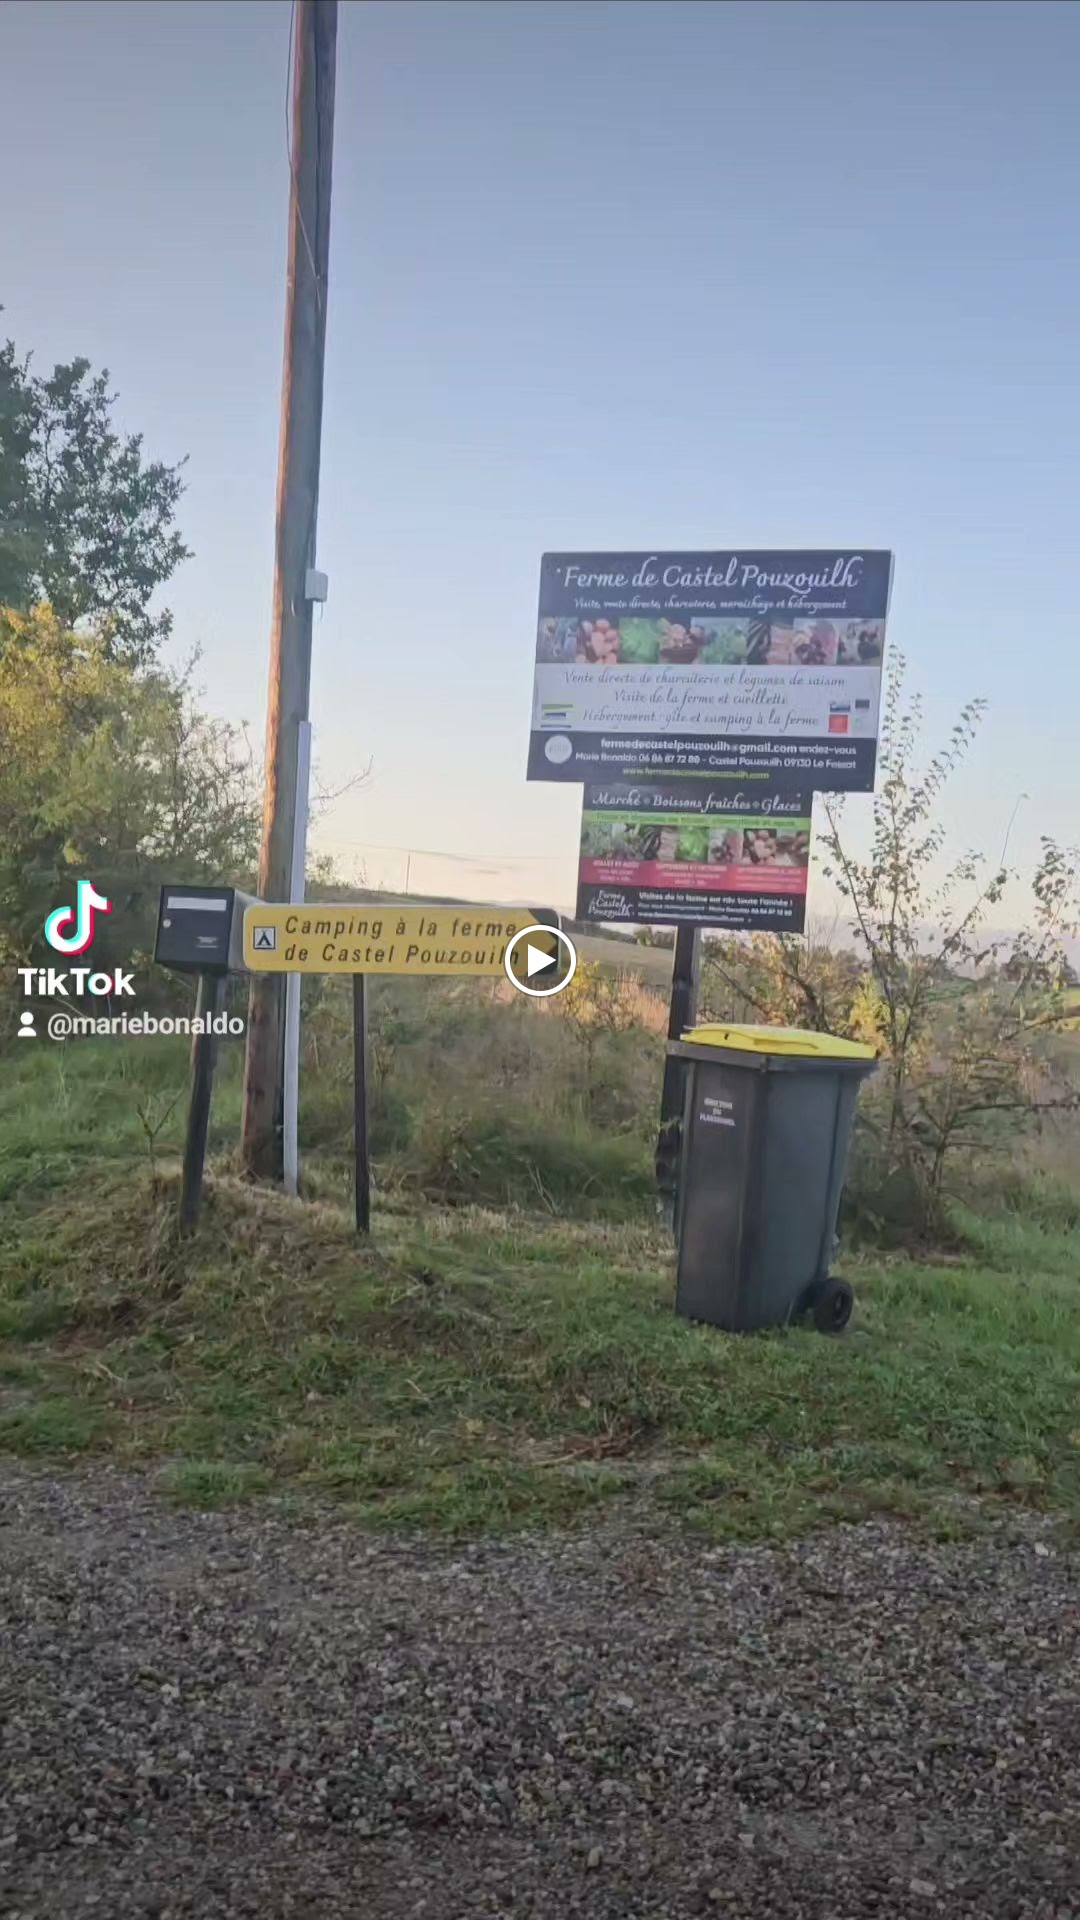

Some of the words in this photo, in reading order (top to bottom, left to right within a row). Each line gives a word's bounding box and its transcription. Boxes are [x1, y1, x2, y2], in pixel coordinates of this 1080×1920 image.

[564, 566, 629, 587] Ferme
[631, 556, 659, 587] de
[663, 556, 738, 587] Castel
[741, 556, 864, 594] Pouzouilh
[564, 671, 594, 684] Vente
[598, 667, 635, 684] directe
[723, 673, 735, 685] et
[789, 671, 804, 685] de
[615, 688, 646, 703] Visite
[649, 686, 663, 703] de
[666, 687, 678, 703] la
[678, 688, 713, 713] ferme
[718, 693, 729, 704] et
[768, 708, 780, 725] la
[780, 708, 819, 733] ferme
[708, 755, 738, 766] Castel
[813, 759, 825, 768] Le
[653, 795, 702, 809] Boissons
[761, 794, 801, 815] Glaces
[285, 916, 383, 938] Camping
[396, 917, 406, 936] à
[418, 918, 437, 937] la
[452, 918, 517, 937] ferme
[284, 946, 309, 963] de
[322, 944, 395, 964] Castel
